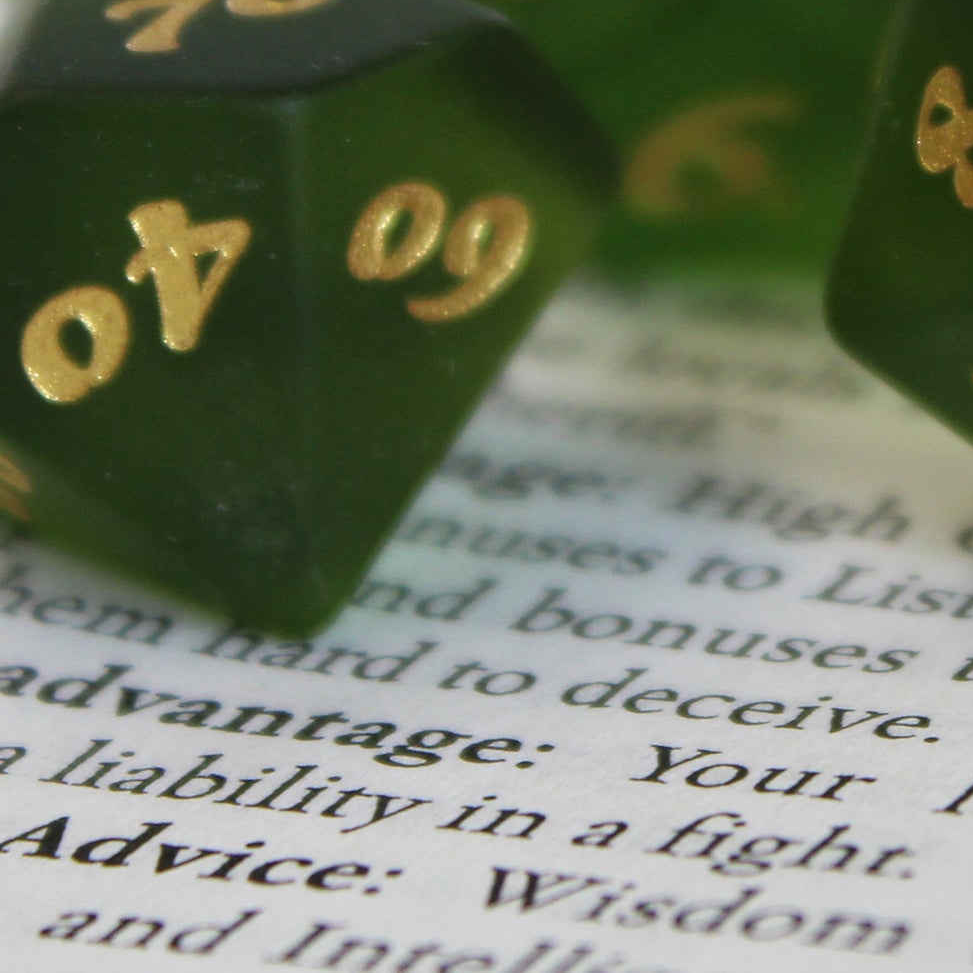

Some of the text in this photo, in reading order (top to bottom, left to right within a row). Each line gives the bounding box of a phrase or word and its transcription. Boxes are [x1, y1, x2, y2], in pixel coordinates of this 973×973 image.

[402, 517, 668, 577] nuses
[685, 553, 783, 592] to
[350, 578, 498, 622] nd
[508, 587, 920, 675] bonuses
[0, 664, 557, 769] advantage:
[629, 744, 876, 801] Your
[436, 661, 537, 696] to
[559, 667, 941, 743] deceive.
[38, 738, 433, 834] liability
[436, 795, 547, 840] in
[571, 820, 628, 848] a
[645, 811, 916, 880] fight.
[0, 816, 404, 895] Advice:
[484, 865, 910, 955] Wisdom
[38, 908, 262, 956] and
